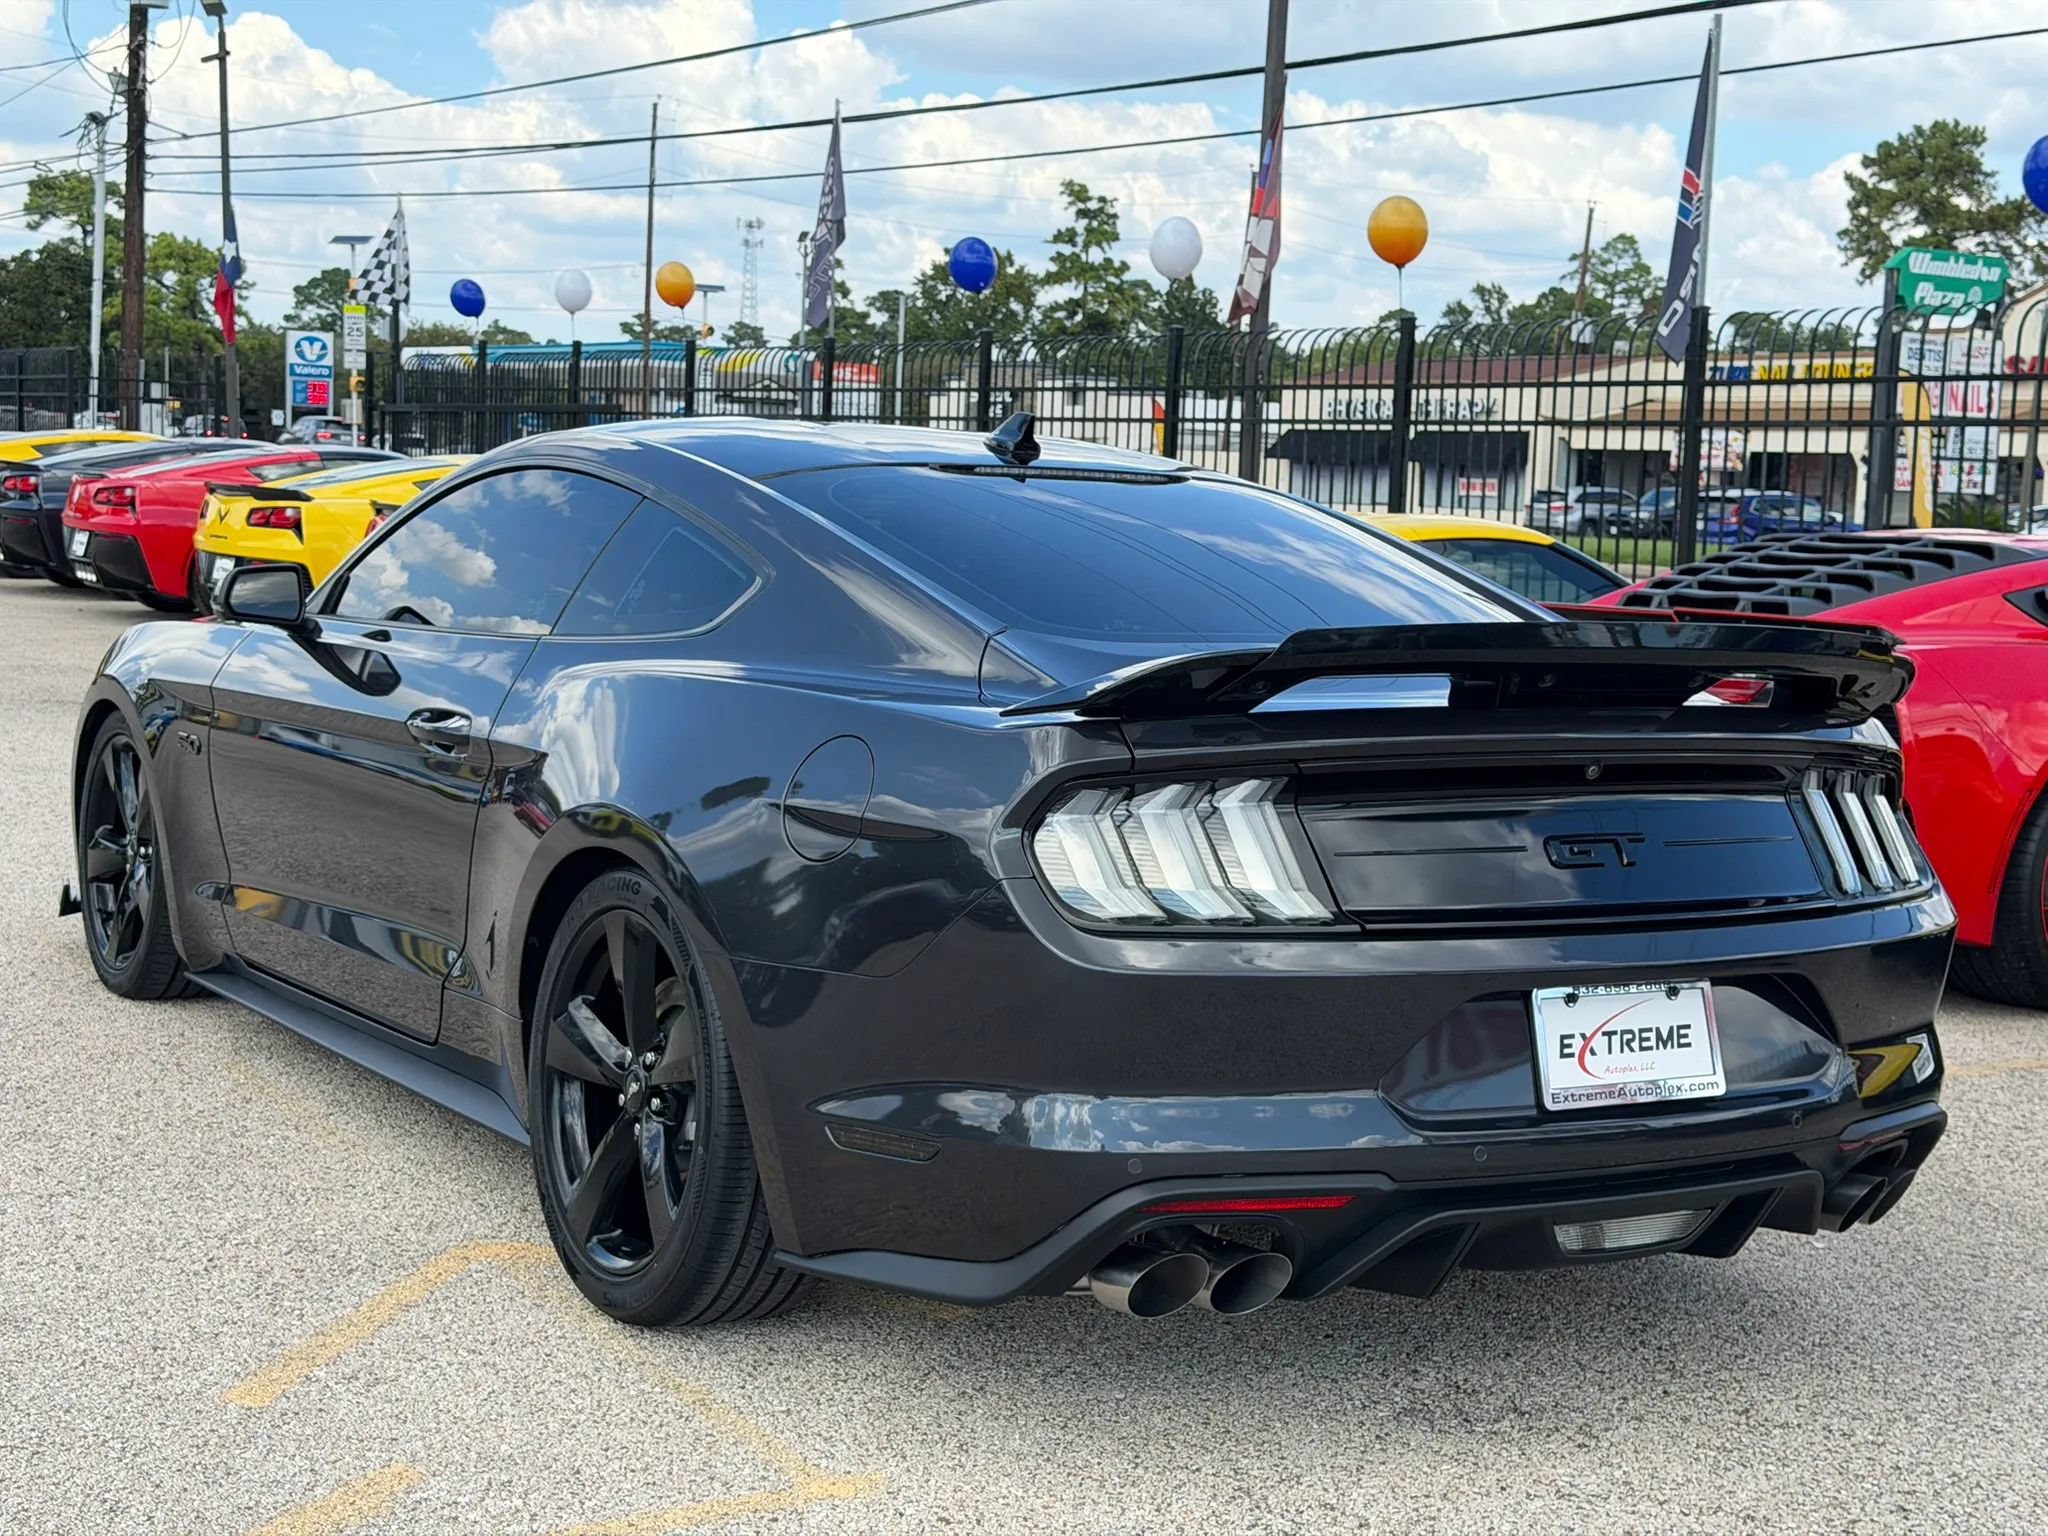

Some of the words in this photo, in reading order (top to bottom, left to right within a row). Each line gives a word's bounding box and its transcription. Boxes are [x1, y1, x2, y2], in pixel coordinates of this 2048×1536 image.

[1908, 251, 2001, 282] Wimbledon
[1914, 281, 1966, 308] Plaza
[347, 326, 364, 338] 25
[293, 364, 330, 376] Valero
[1326, 399, 1399, 421] PHYSICA
[1543, 832, 1645, 870] GT
[1559, 1023, 1692, 1059] EXTREME
[1552, 1079, 1720, 1104] ExtremeAutoplex.com
